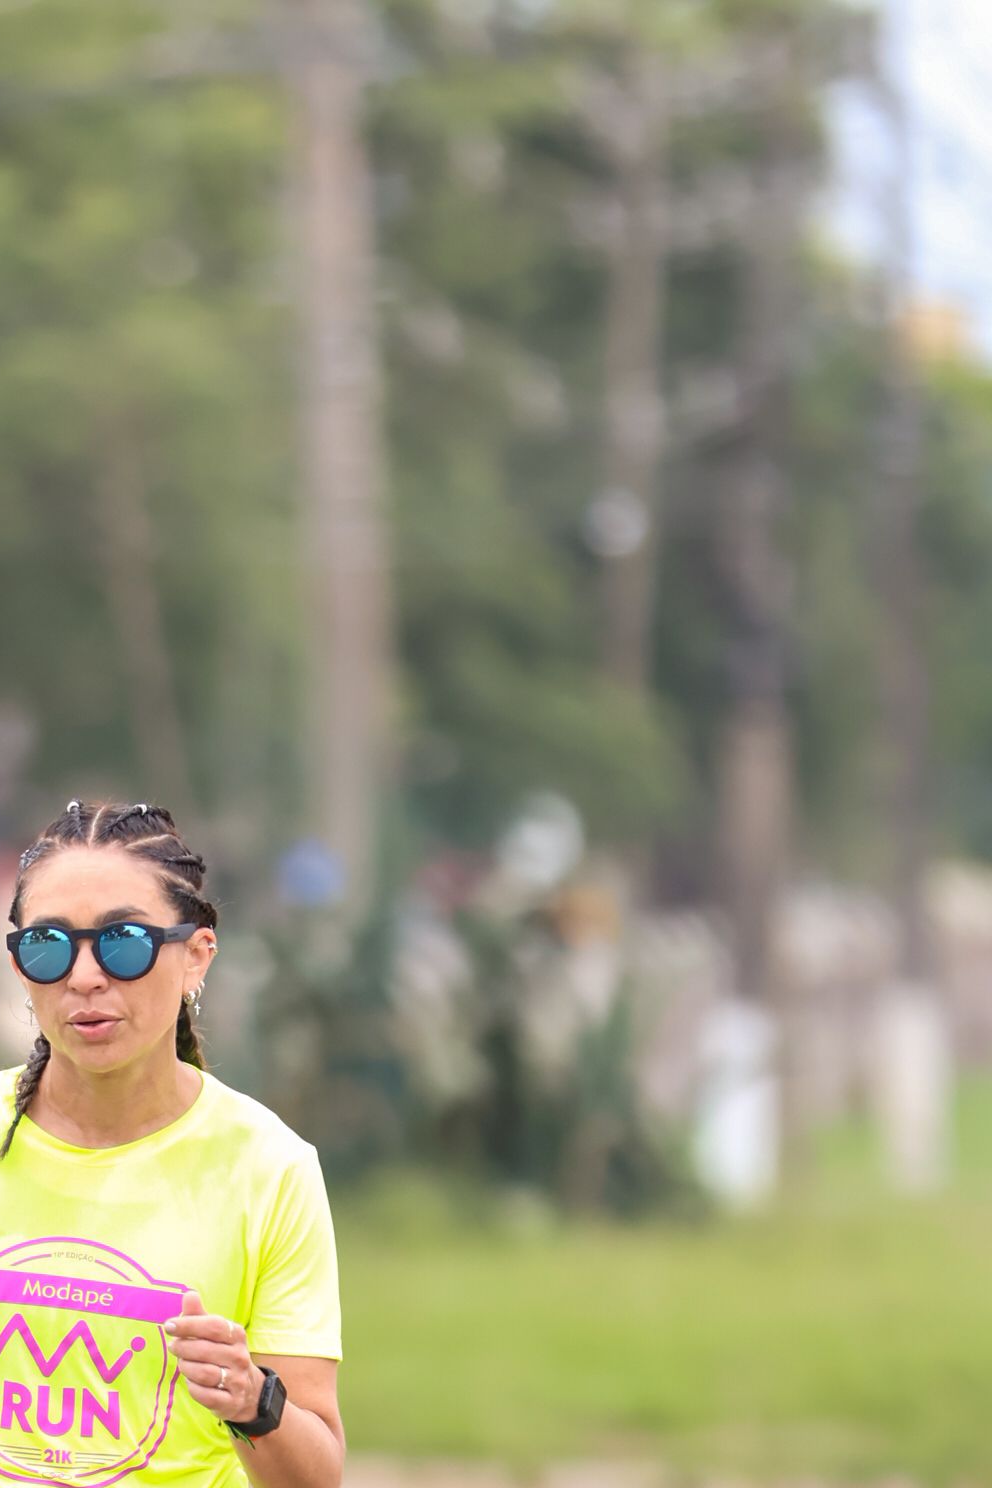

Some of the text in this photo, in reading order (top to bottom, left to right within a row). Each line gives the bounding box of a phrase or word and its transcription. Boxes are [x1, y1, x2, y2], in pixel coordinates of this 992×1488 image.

[65, 1251, 94, 1263] EDIÇÃO
[22, 1279, 114, 1307] Modapé
[0, 1380, 121, 1440] RUN
[43, 1449, 72, 1464] 21K
